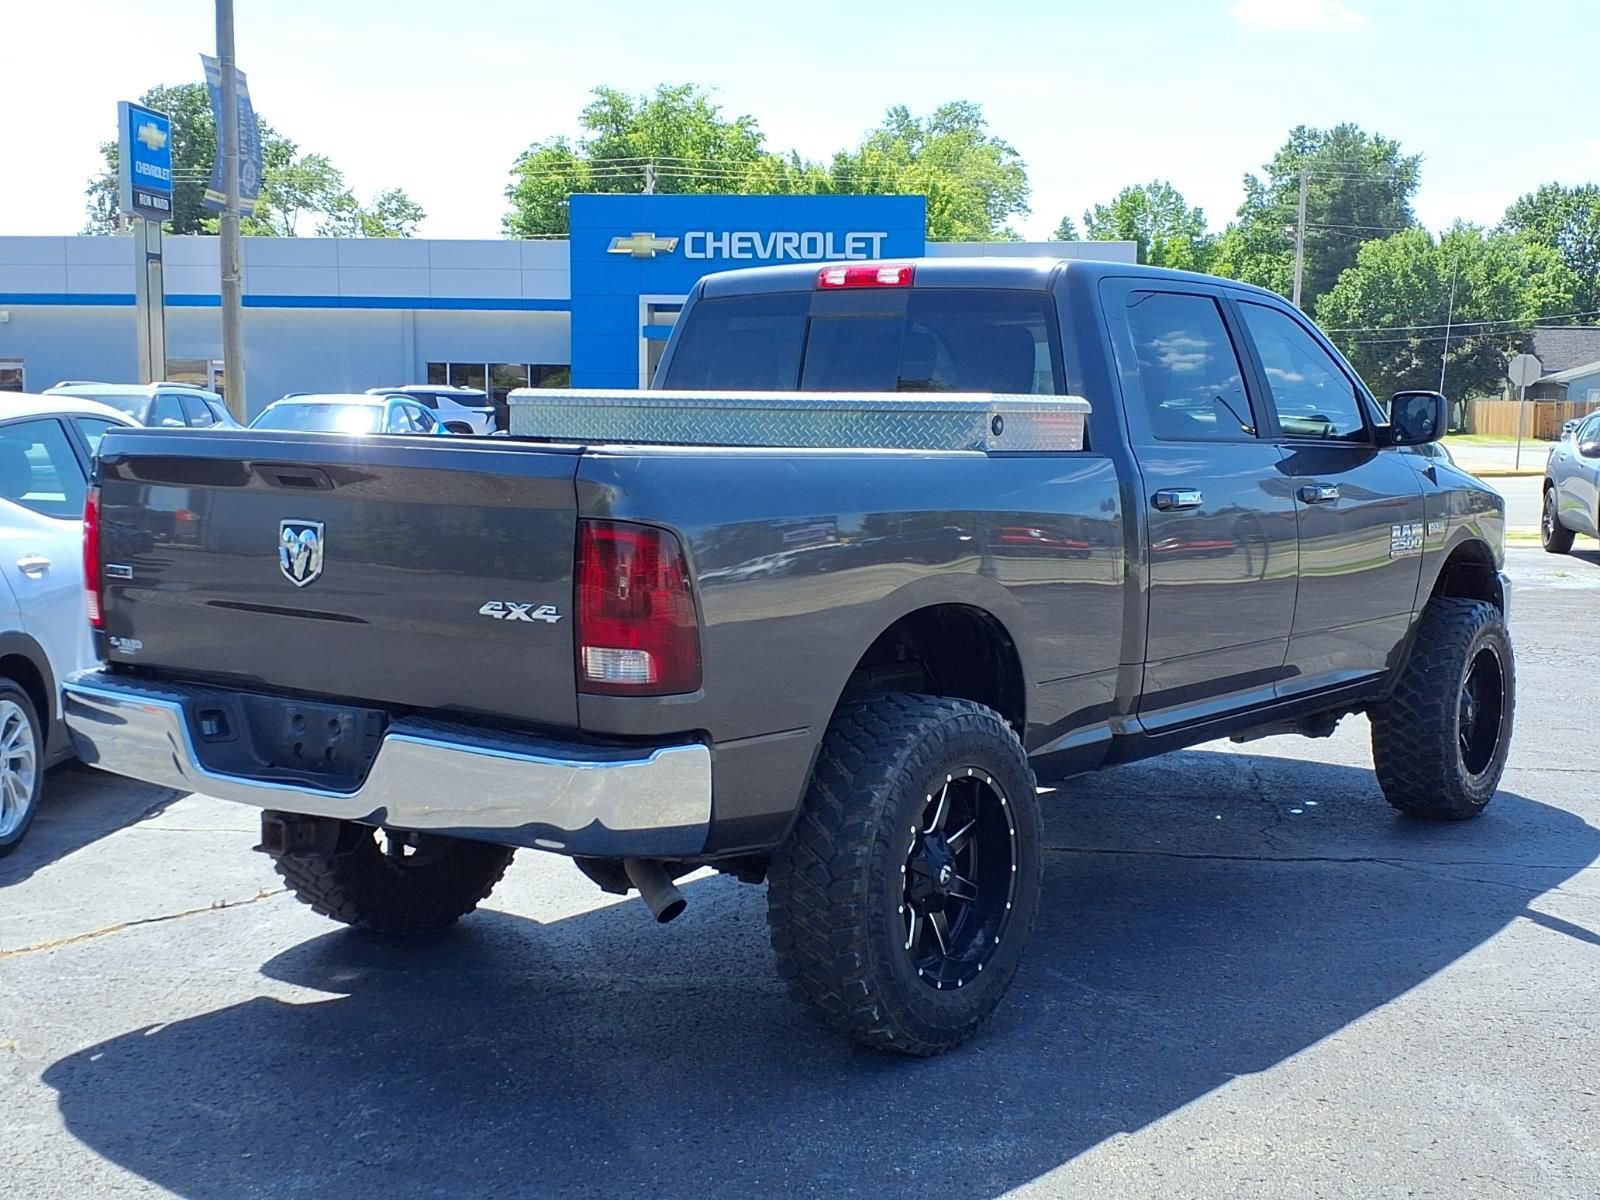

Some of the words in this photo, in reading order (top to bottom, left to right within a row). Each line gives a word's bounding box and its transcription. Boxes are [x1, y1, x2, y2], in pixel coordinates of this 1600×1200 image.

[135, 160, 170, 180] CHEVROLET
[684, 231, 888, 260] CHEVROLET
[1391, 524, 1424, 538] RAM
[1391, 536, 1422, 551] 2500
